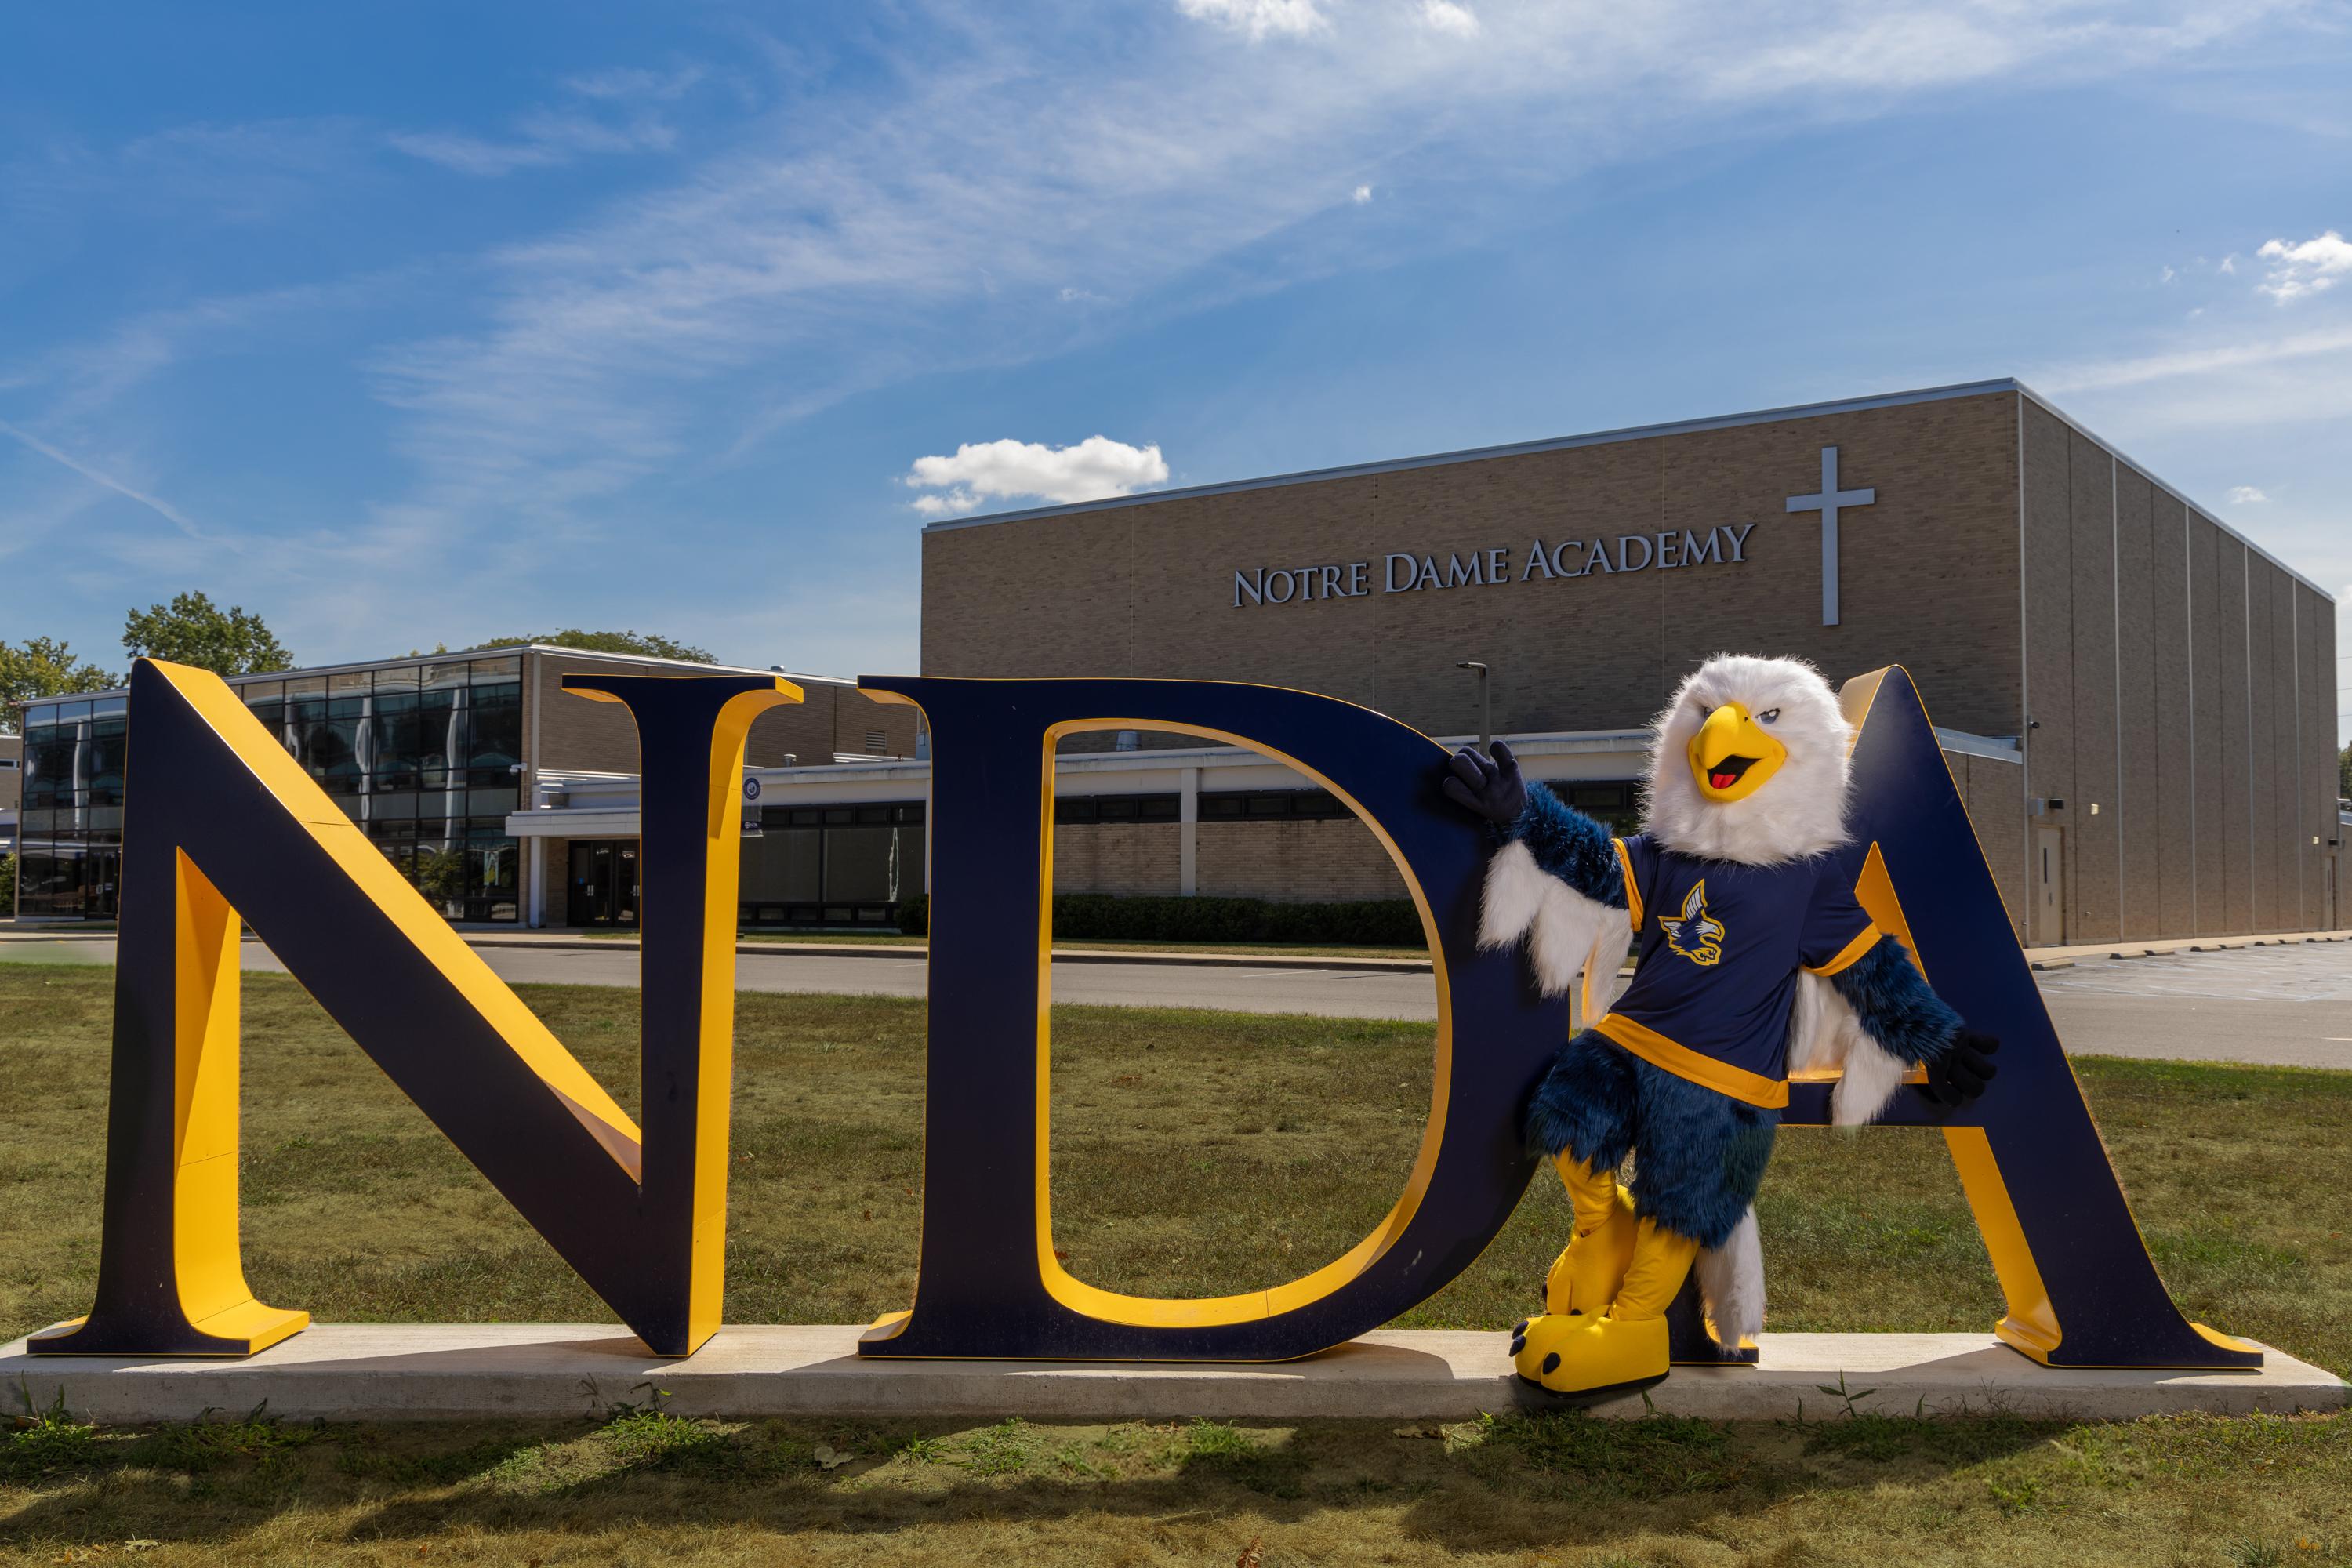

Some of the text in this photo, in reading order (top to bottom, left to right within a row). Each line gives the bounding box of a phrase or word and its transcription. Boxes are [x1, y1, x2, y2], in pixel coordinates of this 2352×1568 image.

[1233, 523, 1756, 608] NOTRE DAME ACADEMY
